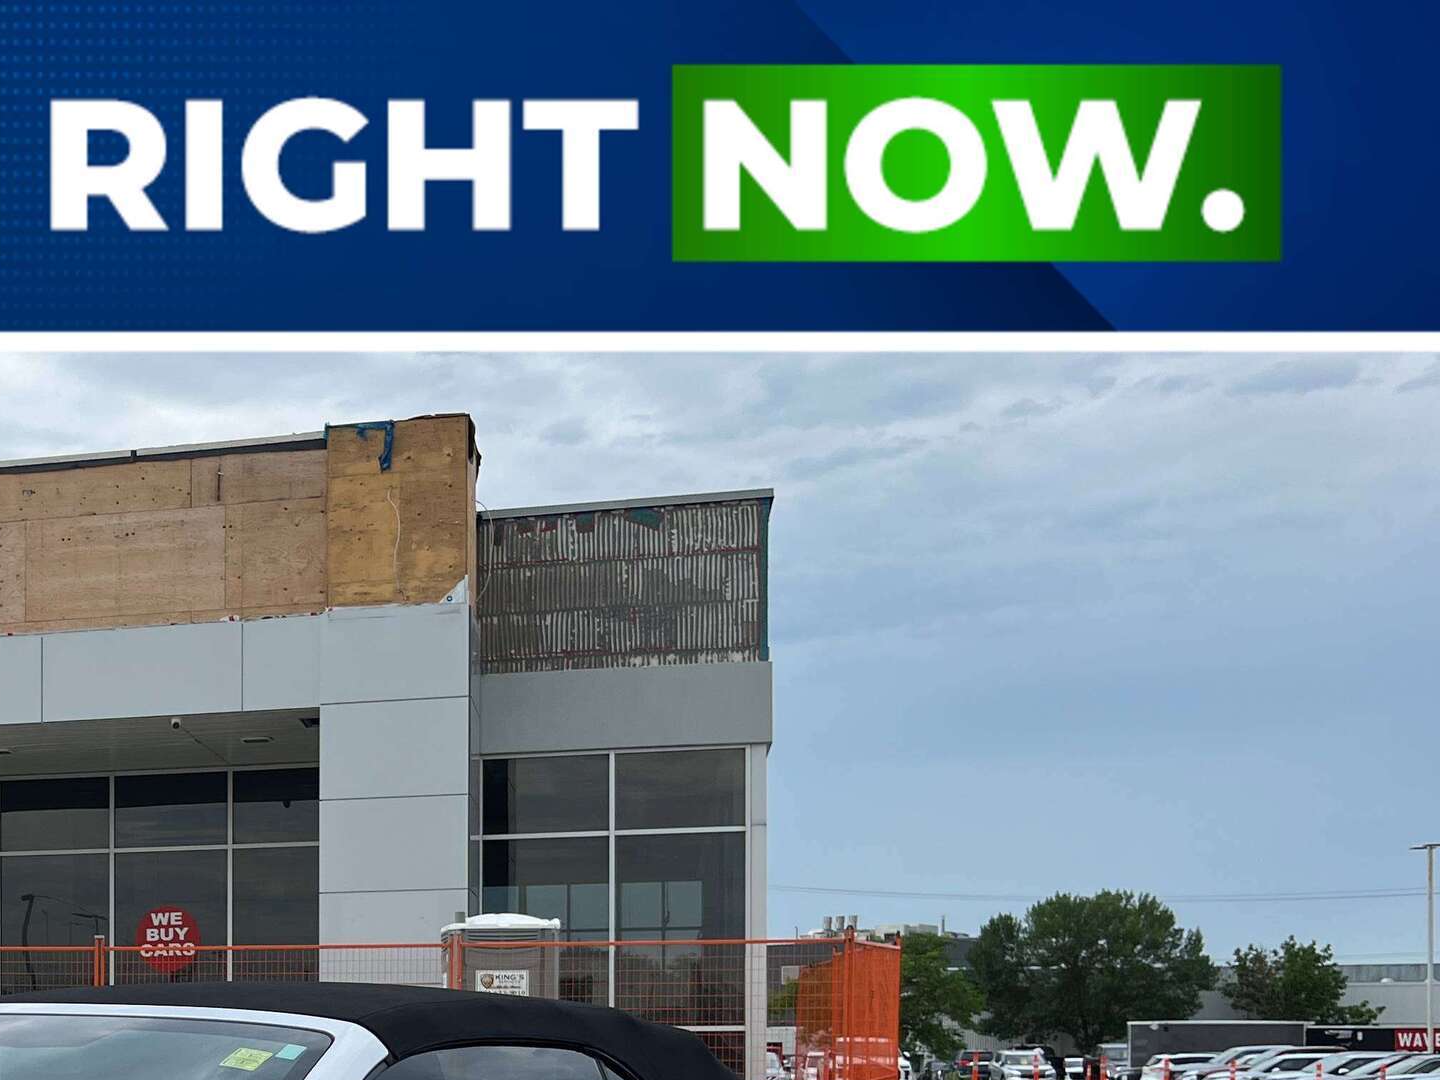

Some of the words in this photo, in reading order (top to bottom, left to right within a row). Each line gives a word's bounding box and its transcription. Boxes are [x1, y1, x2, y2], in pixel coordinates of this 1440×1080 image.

[151, 912, 183, 926] WE
[146, 927, 189, 942] BUY
[140, 942, 196, 957] CARS
